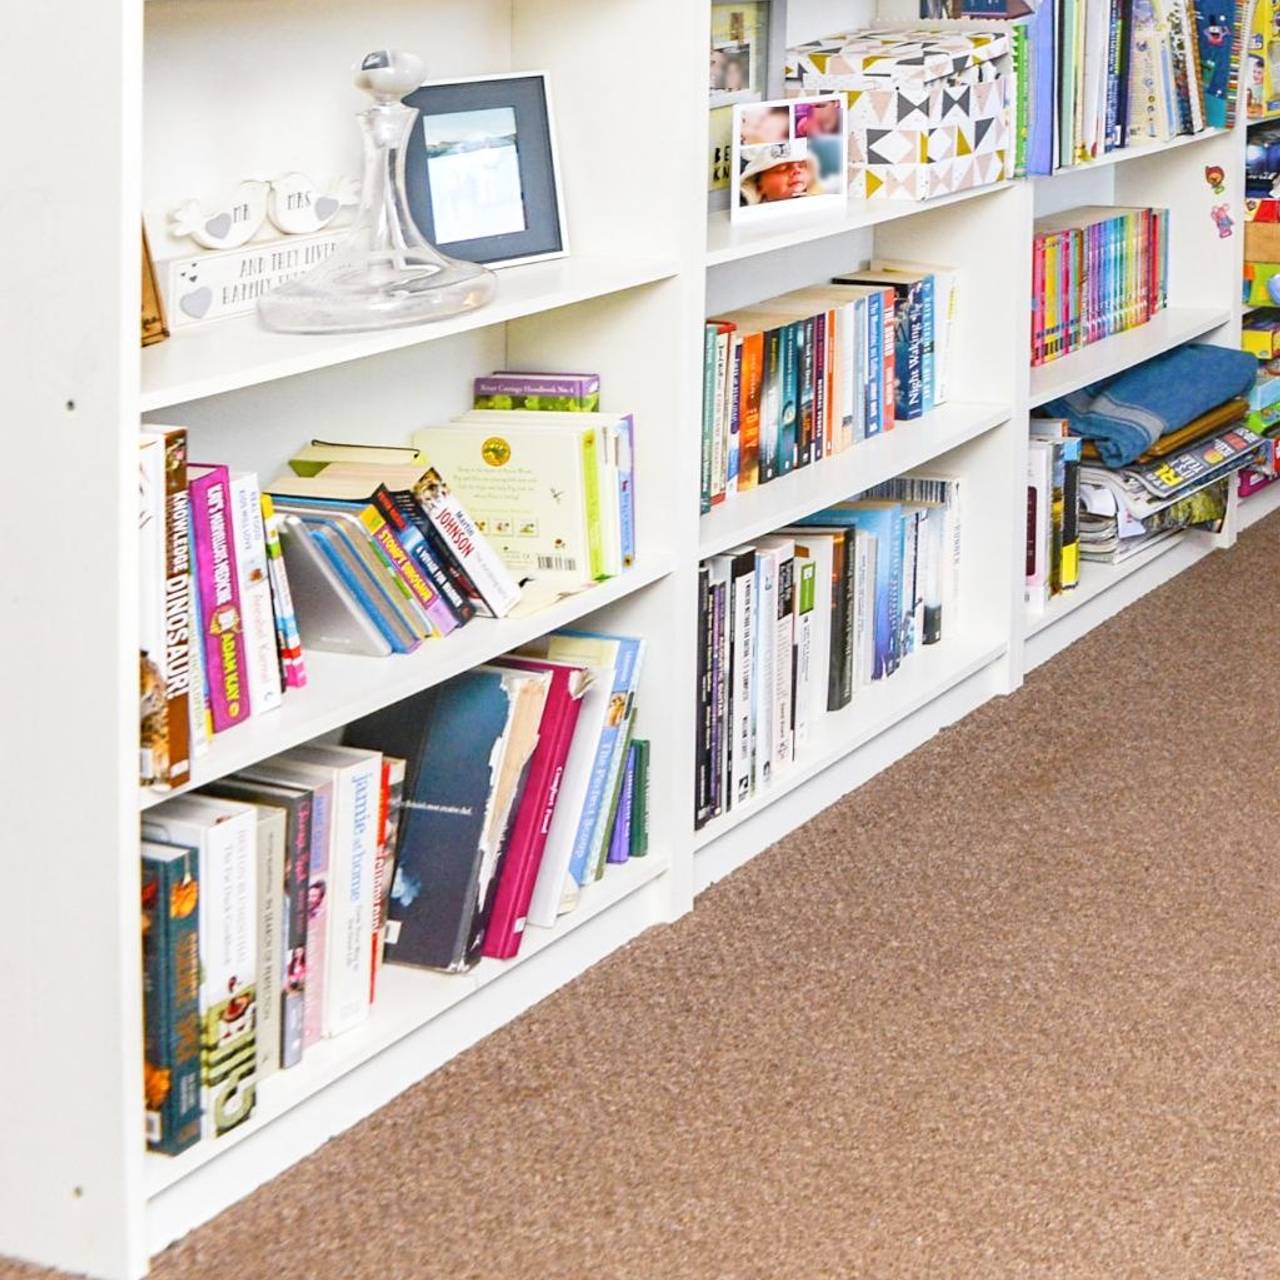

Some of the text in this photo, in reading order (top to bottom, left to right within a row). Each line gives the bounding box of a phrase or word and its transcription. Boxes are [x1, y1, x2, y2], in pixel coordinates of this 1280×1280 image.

[908, 324, 921, 406] Night Waking
[173, 490, 190, 575] KNOWLEDGE
[207, 482, 232, 607] KAY'S MARVELLOUS MEDICINE
[435, 507, 475, 559] JOHNSON
[455, 510, 475, 538] Martin
[419, 549, 440, 577] VOYAGE
[433, 569, 448, 588] FOR
[166, 573, 190, 700] DINOSAUR!
[222, 632, 240, 701] ADAM KAY
[351, 772, 374, 835] jamie
[547, 766, 563, 807] Comfort
[574, 741, 612, 859] The Perfect Scoop
[353, 837, 362, 850] at
[349, 851, 366, 903] home
